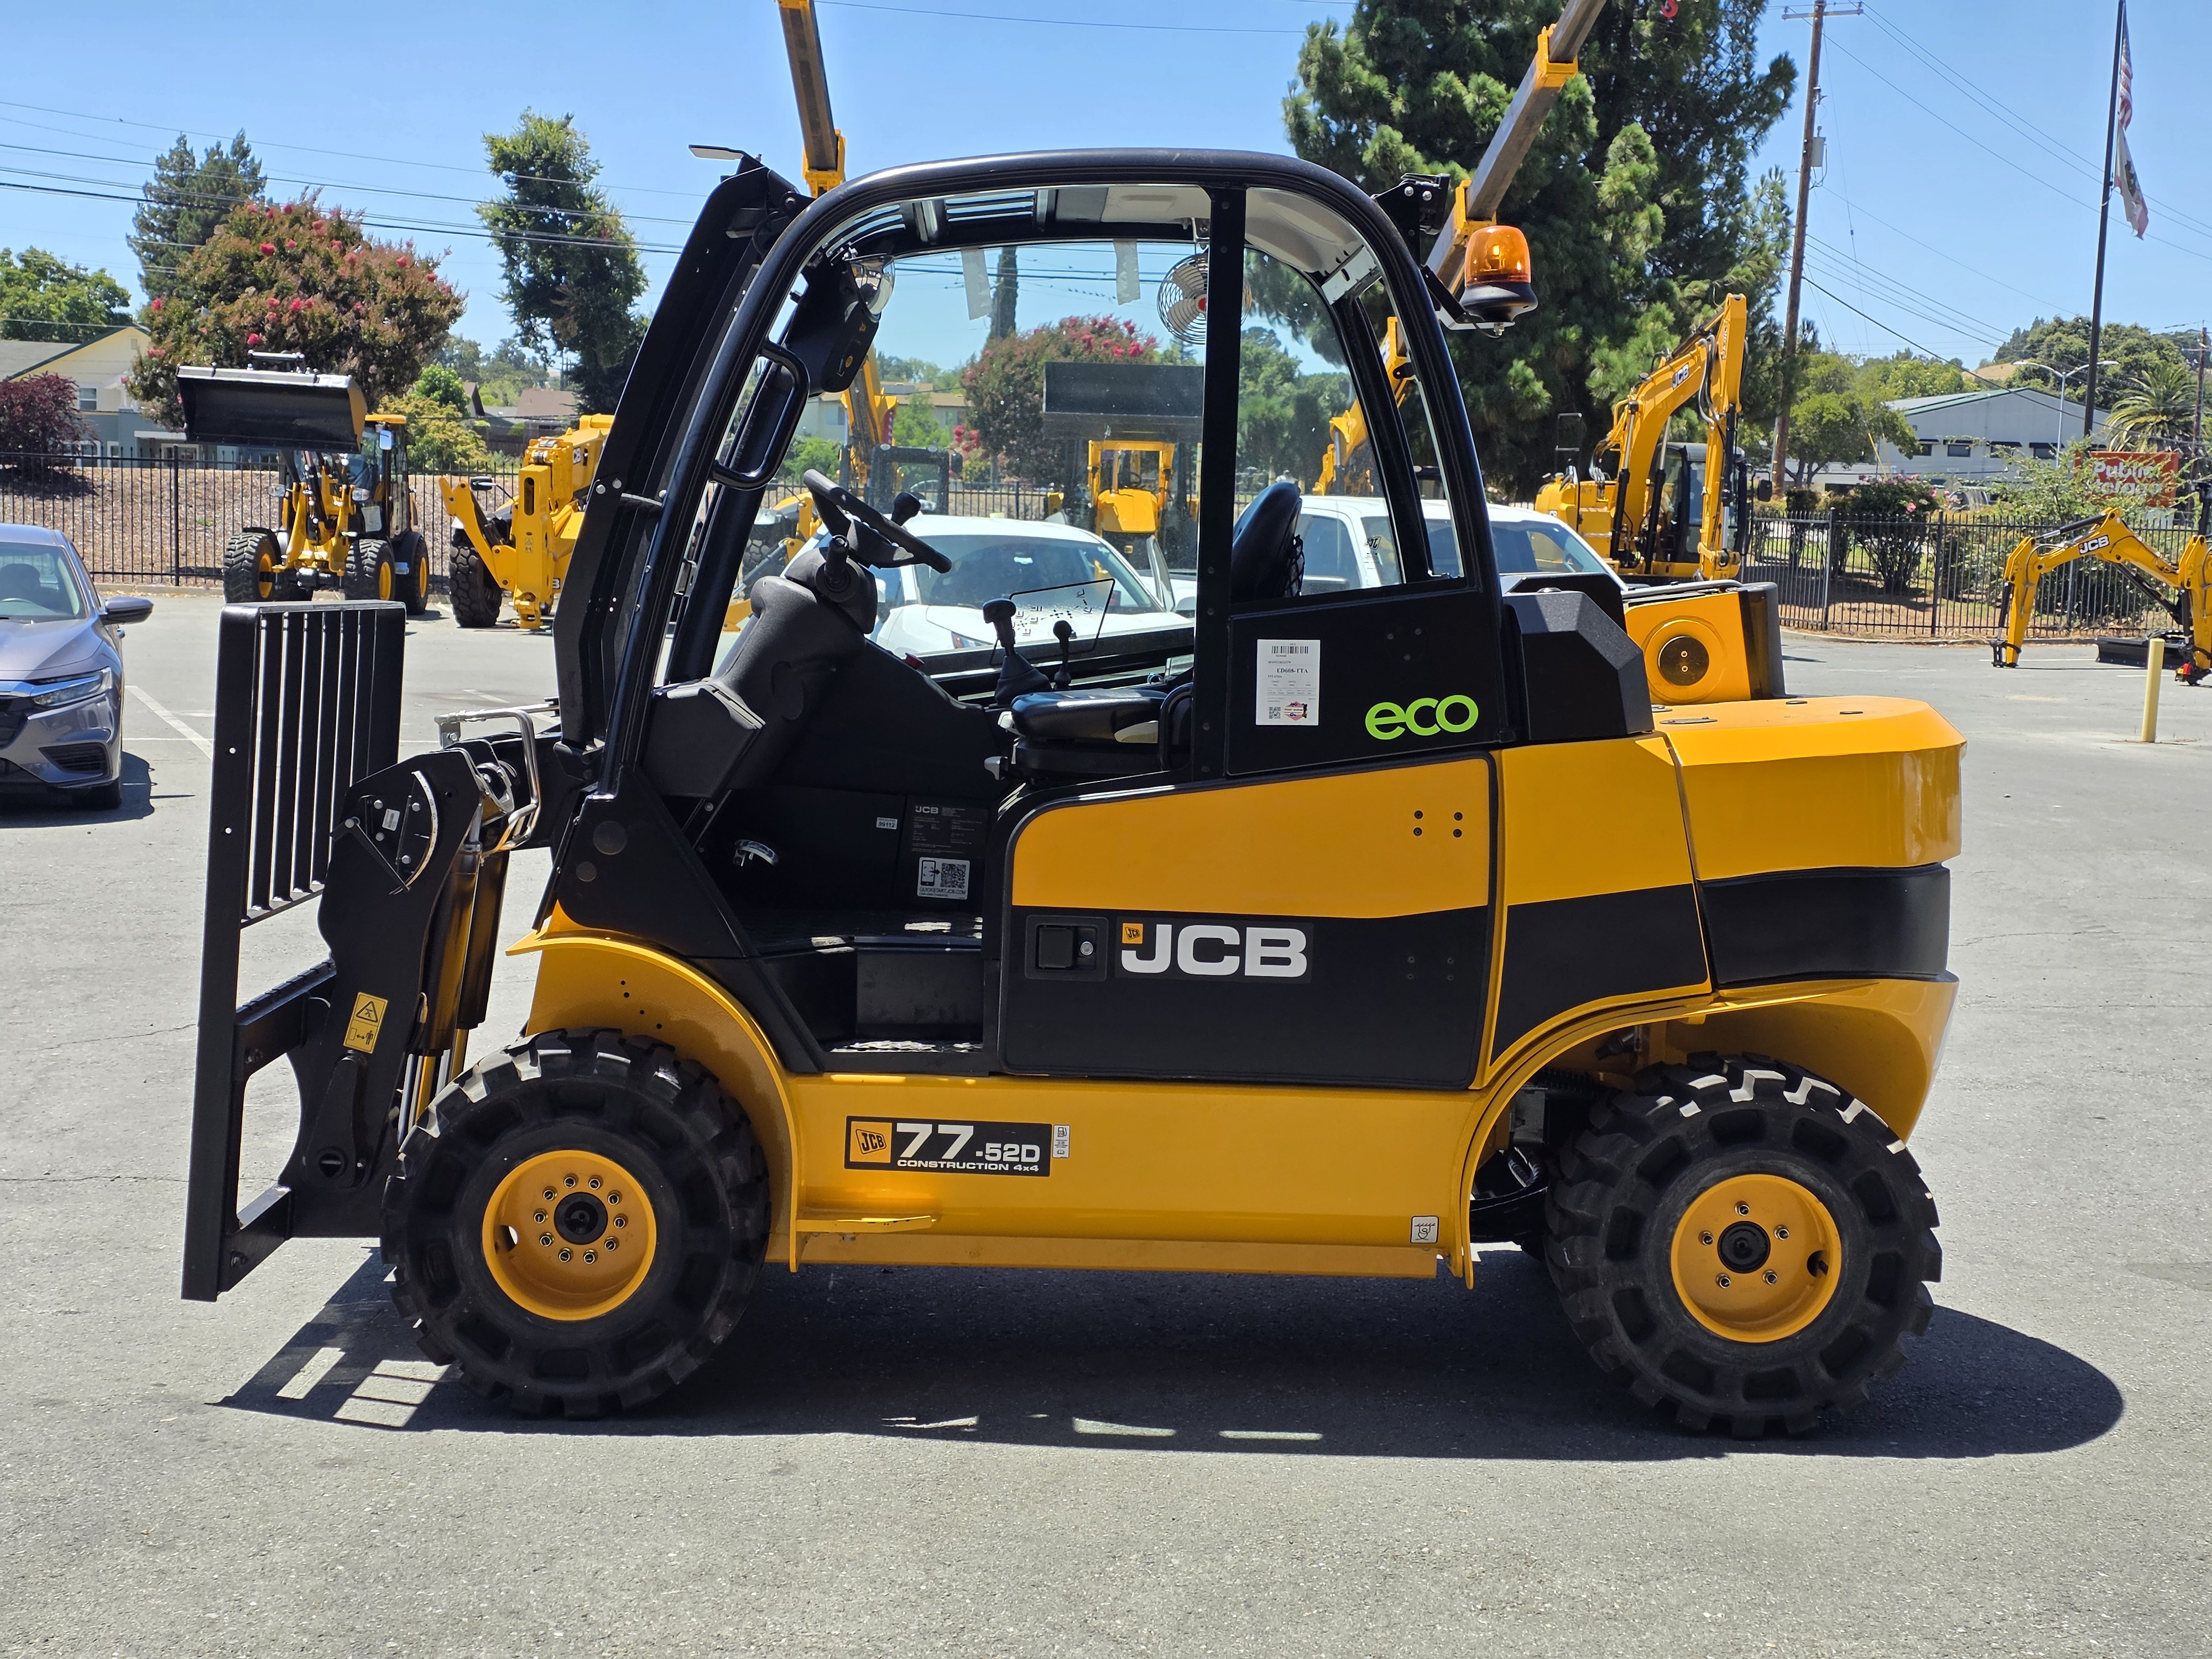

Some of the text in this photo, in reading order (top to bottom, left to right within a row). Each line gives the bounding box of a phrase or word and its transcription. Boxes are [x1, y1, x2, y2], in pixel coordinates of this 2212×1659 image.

[1673, 364, 1689, 389] JCB
[2079, 536, 2109, 554] JCB
[1365, 695, 1479, 740] eco
[915, 805, 939, 814] JCB
[1128, 928, 1140, 938] JCB
[1121, 924, 1307, 977] JCB
[861, 1132, 884, 1151] JCB
[897, 1160, 1009, 1171] CONSTRUCTION
